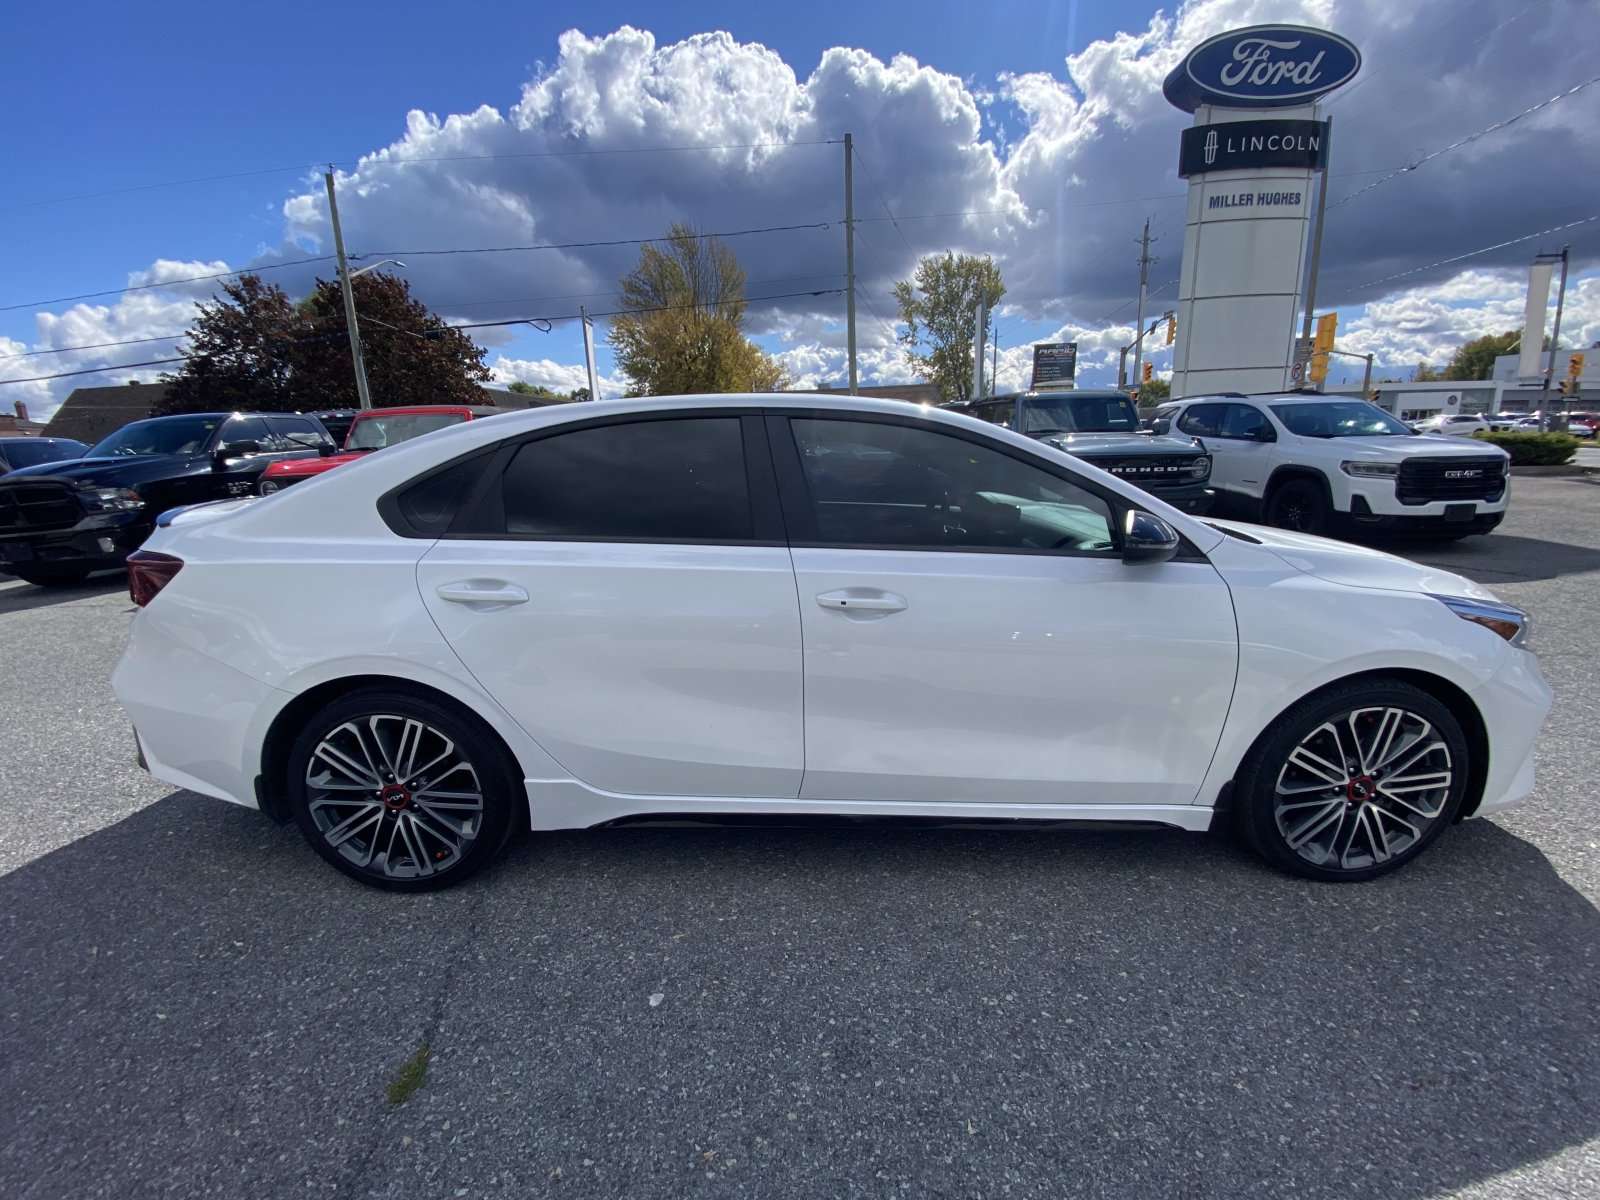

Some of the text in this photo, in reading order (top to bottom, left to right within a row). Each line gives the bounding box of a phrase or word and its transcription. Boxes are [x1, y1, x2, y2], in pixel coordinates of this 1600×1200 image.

[1220, 38, 1326, 86] Ford
[1227, 135, 1320, 153] LINCOLN
[1209, 192, 1302, 208] MILLER HUGHES
